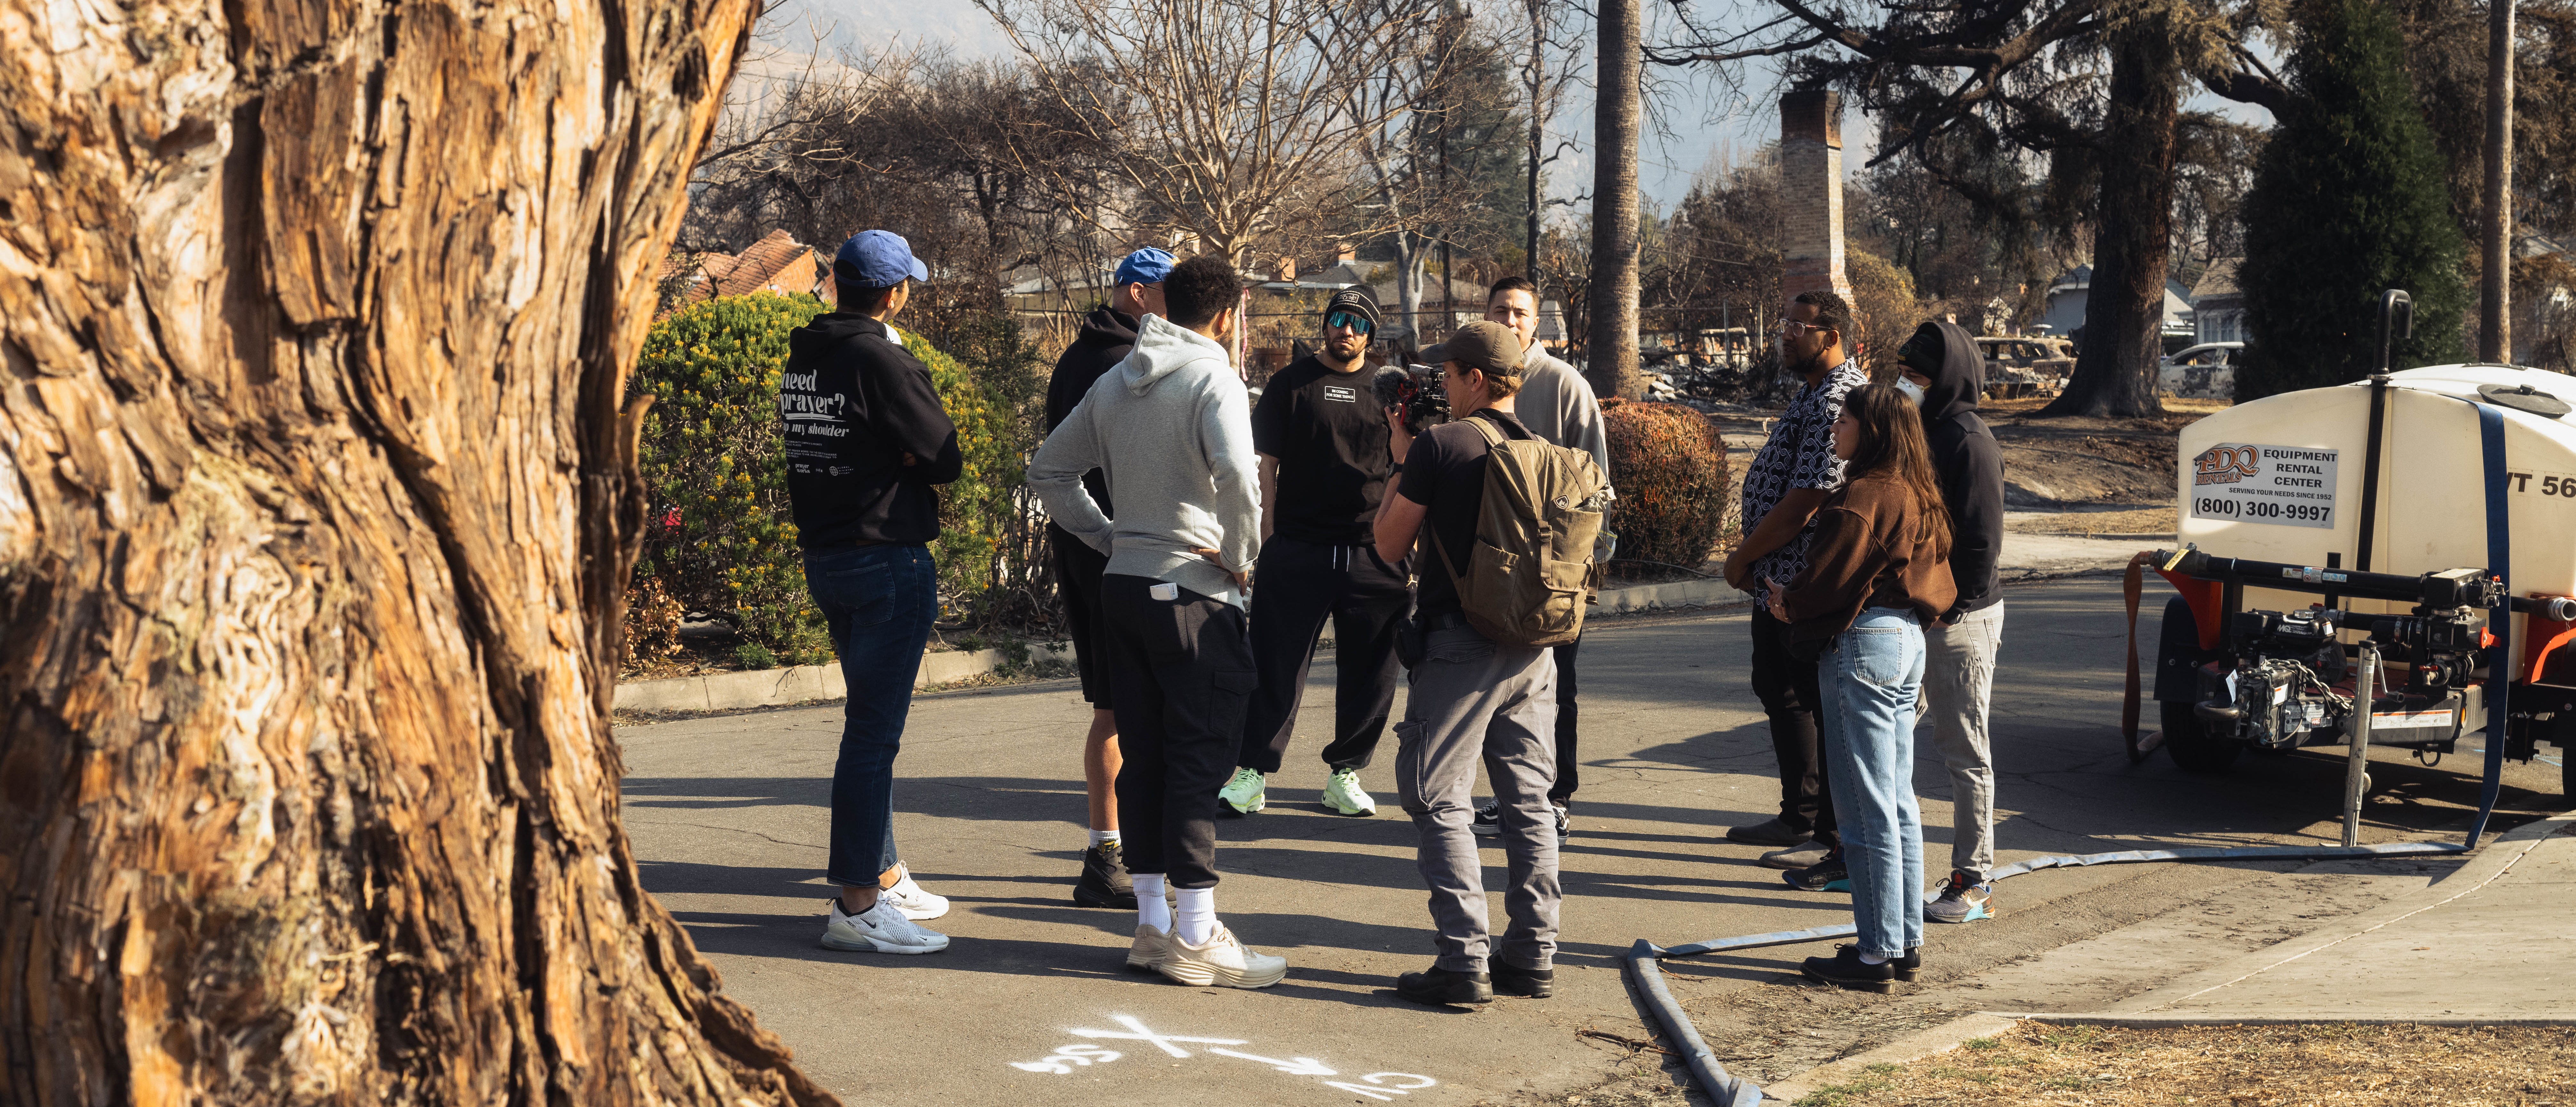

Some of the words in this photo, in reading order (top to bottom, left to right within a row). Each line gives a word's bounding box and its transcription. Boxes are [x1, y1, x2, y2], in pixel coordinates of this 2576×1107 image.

[781, 369, 817, 392] need
[780, 393, 845, 415] prayer?
[791, 424, 807, 436] my
[808, 423, 850, 437] shoulder
[2194, 445, 2260, 477] PDQ
[2263, 449, 2337, 462] EQUIPMENT
[2276, 463, 2323, 475] RENTAL
[2195, 471, 2242, 485] RENTALS
[2274, 476, 2322, 488] CENTER
[2541, 475, 2576, 498] 56
[2195, 497, 2241, 518] (800)
[2246, 501, 2331, 522] 300-9997
[2277, 624, 2291, 633] MQ
